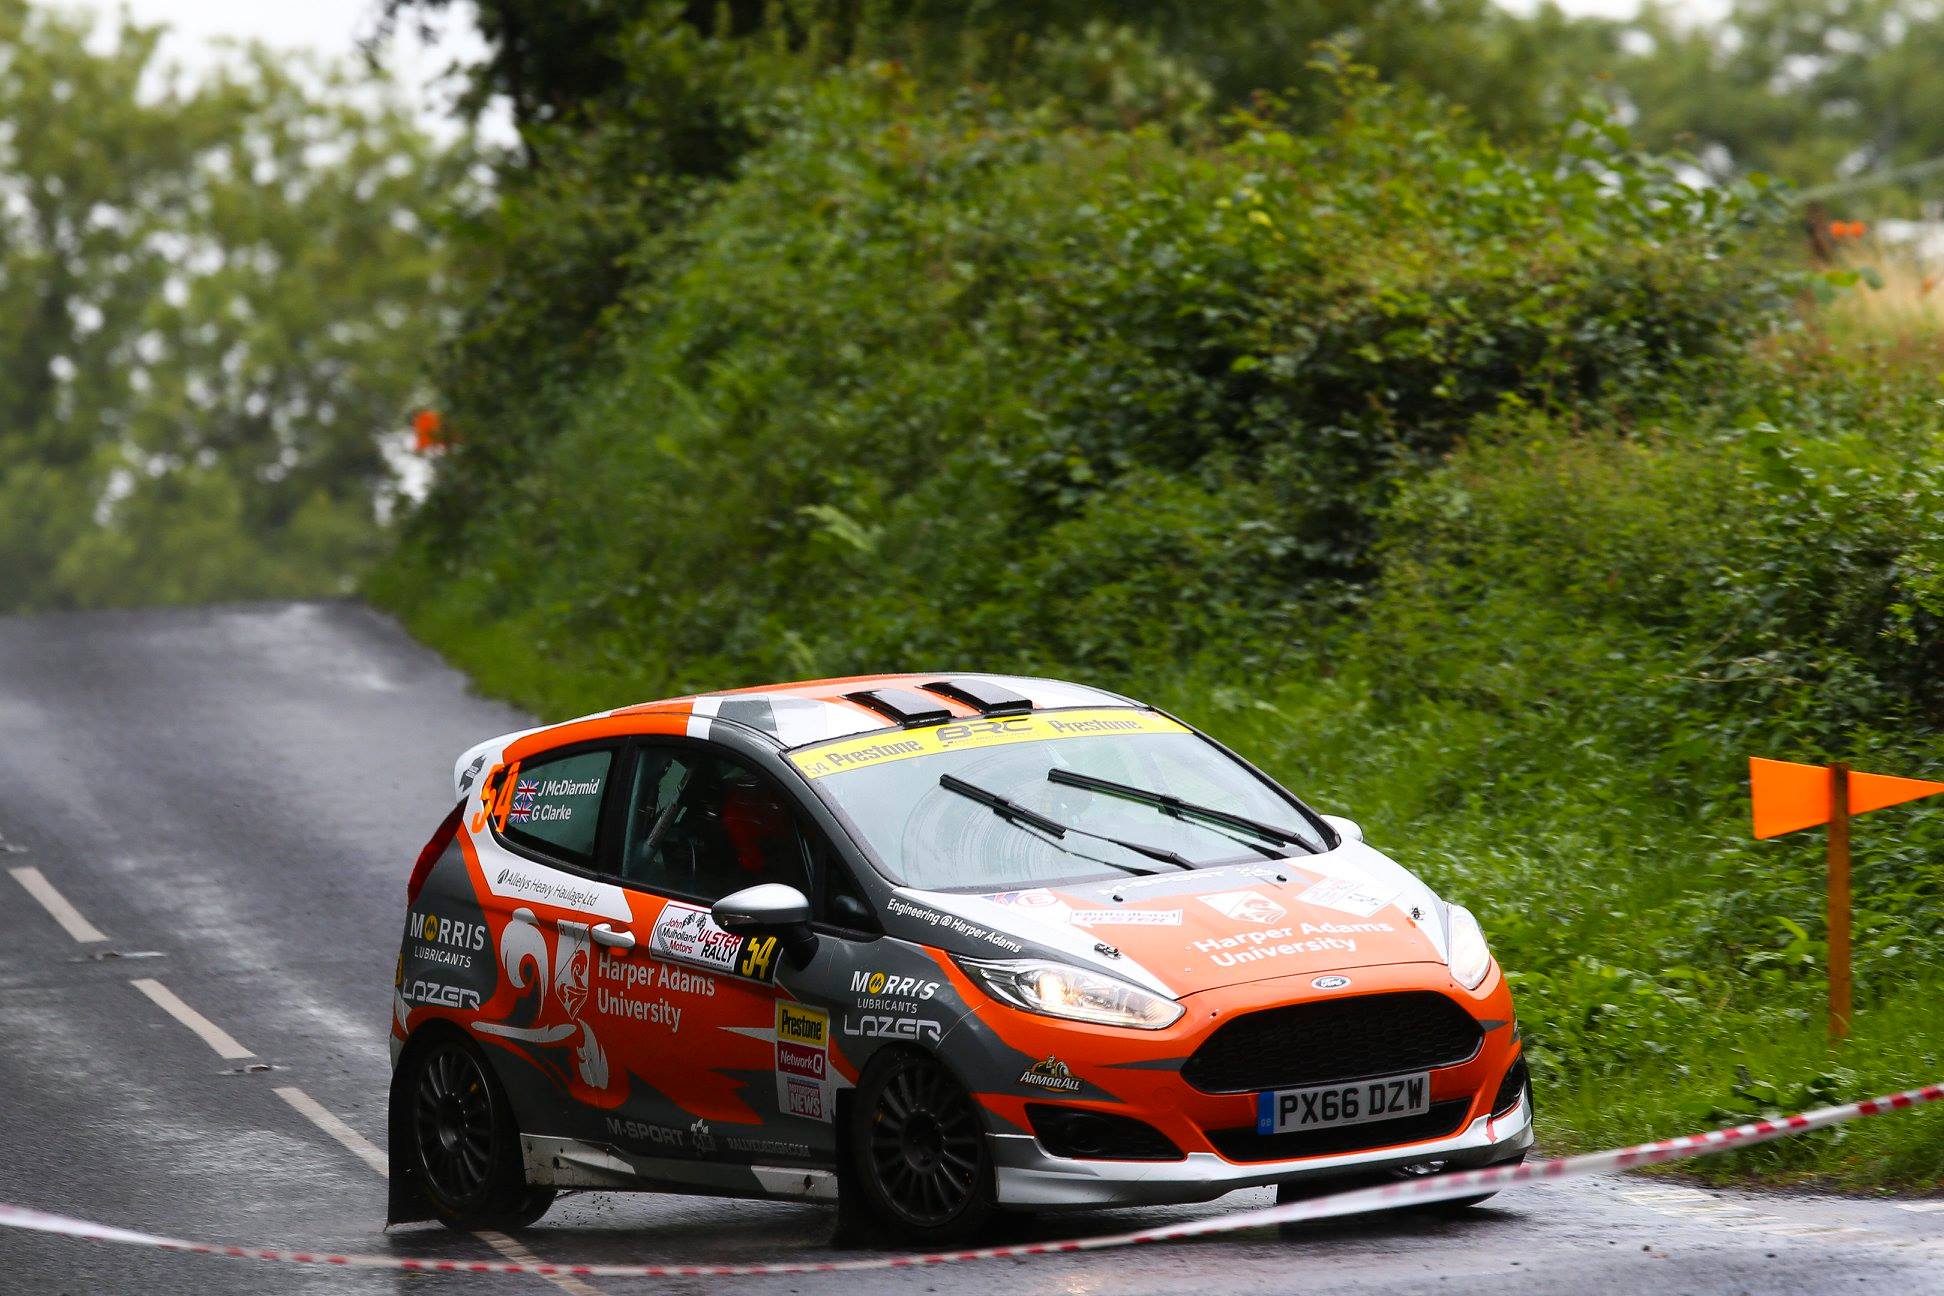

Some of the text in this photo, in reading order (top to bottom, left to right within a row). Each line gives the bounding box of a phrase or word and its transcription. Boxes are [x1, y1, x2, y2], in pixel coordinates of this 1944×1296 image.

[936, 717, 1033, 742] BRC
[1048, 718, 1137, 734] Prestone
[825, 740, 925, 767] Prestone
[538, 779, 600, 797] J McDiarmid
[531, 804, 571, 821] G Clarke
[506, 872, 600, 907] Allelys Heavy Haulage Ltd
[410, 912, 486, 951] MORRIS
[661, 927, 698, 943] Mulholland
[666, 917, 683, 930] John
[887, 898, 1022, 953] Engineering @ Harper Adams
[669, 940, 693, 954] Motors
[697, 928, 744, 949] ULSTER
[1192, 922, 1395, 953] Harper Adams
[414, 945, 472, 968] LUBRICANTS
[700, 944, 738, 963] RALLY
[742, 936, 777, 980] 54
[1210, 936, 1357, 967] University
[598, 952, 656, 990] Harper
[657, 963, 715, 997] Adams
[850, 970, 940, 1000] MORRIS
[597, 987, 681, 1033] University
[857, 998, 918, 1014] LUBRICANTS
[781, 1009, 823, 1040] Prestone
[790, 1093, 821, 1117] NEWS
[1279, 1077, 1424, 1127] PX66 DZW
